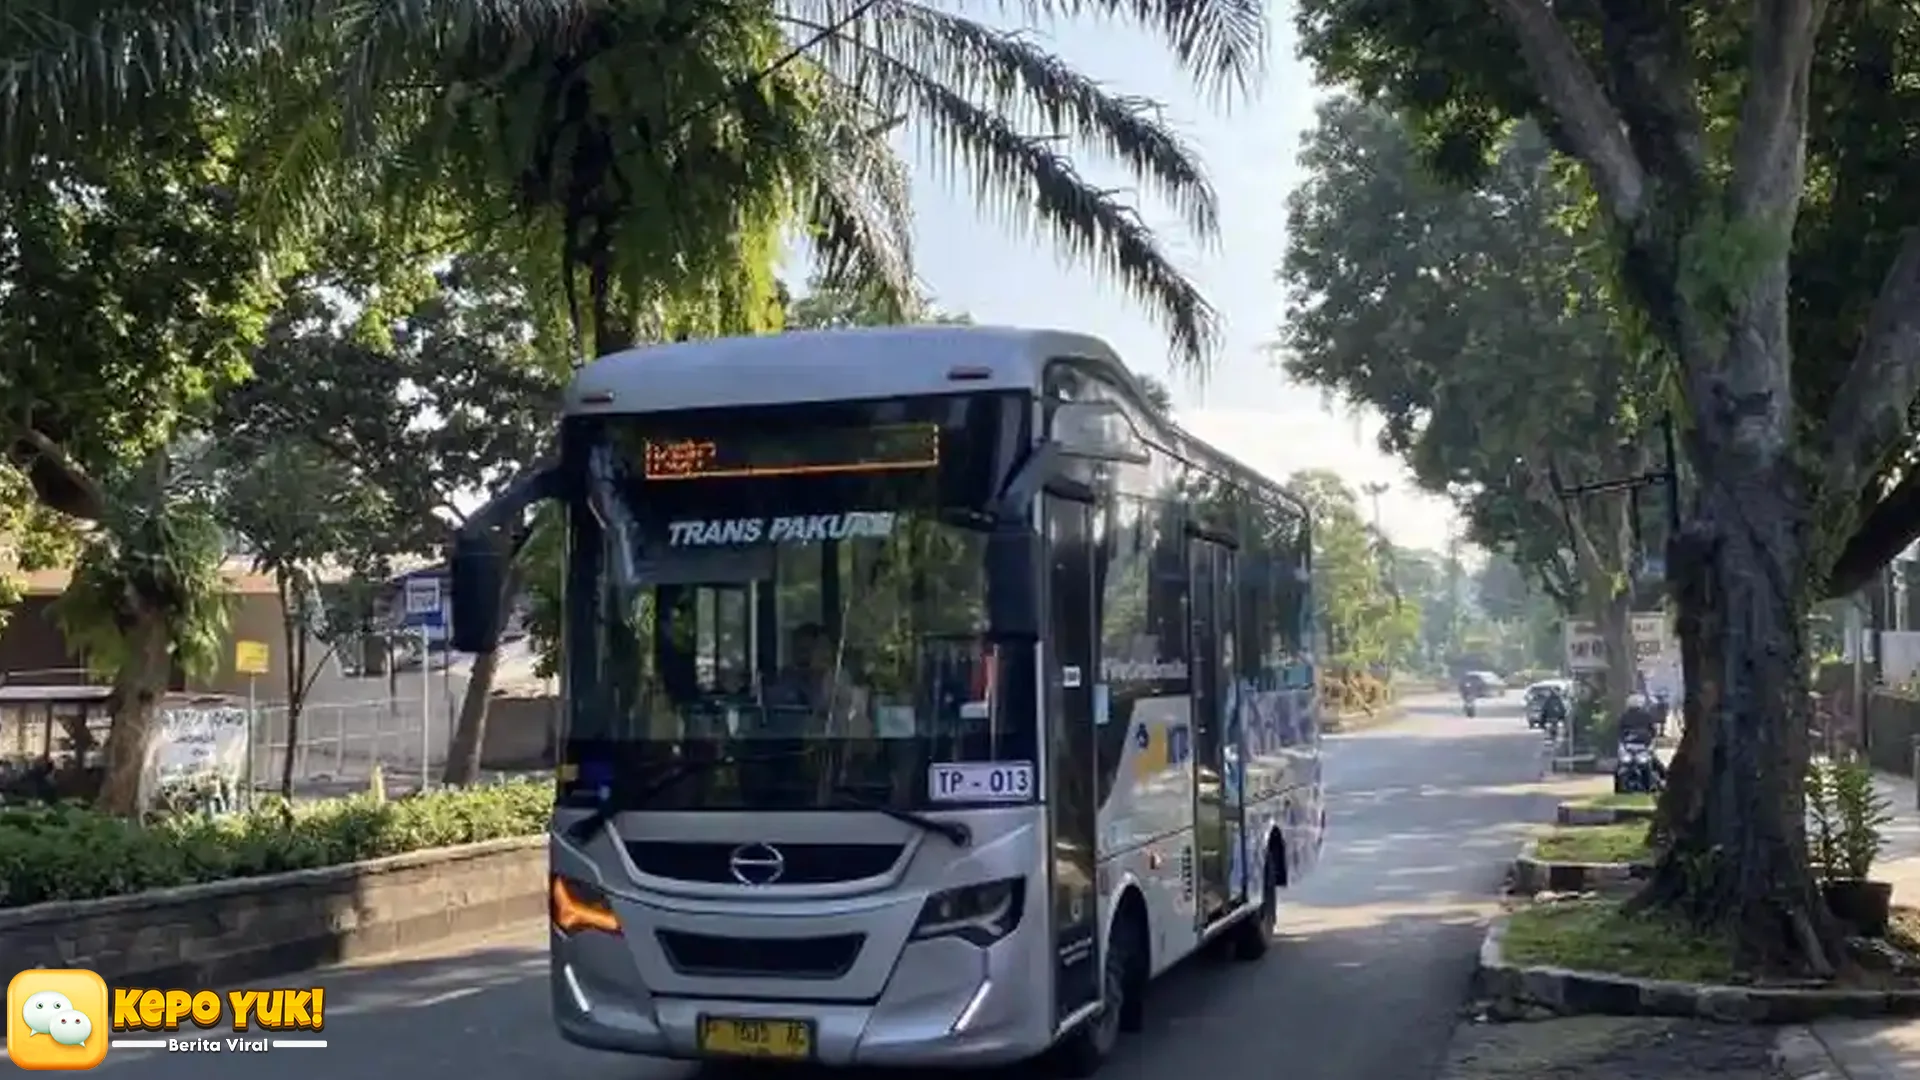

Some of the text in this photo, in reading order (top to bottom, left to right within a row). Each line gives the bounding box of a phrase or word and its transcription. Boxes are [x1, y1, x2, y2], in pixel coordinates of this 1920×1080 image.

[669, 518, 764, 547] TRANS
[940, 770, 964, 794] TP
[990, 769, 1029, 792] 013
